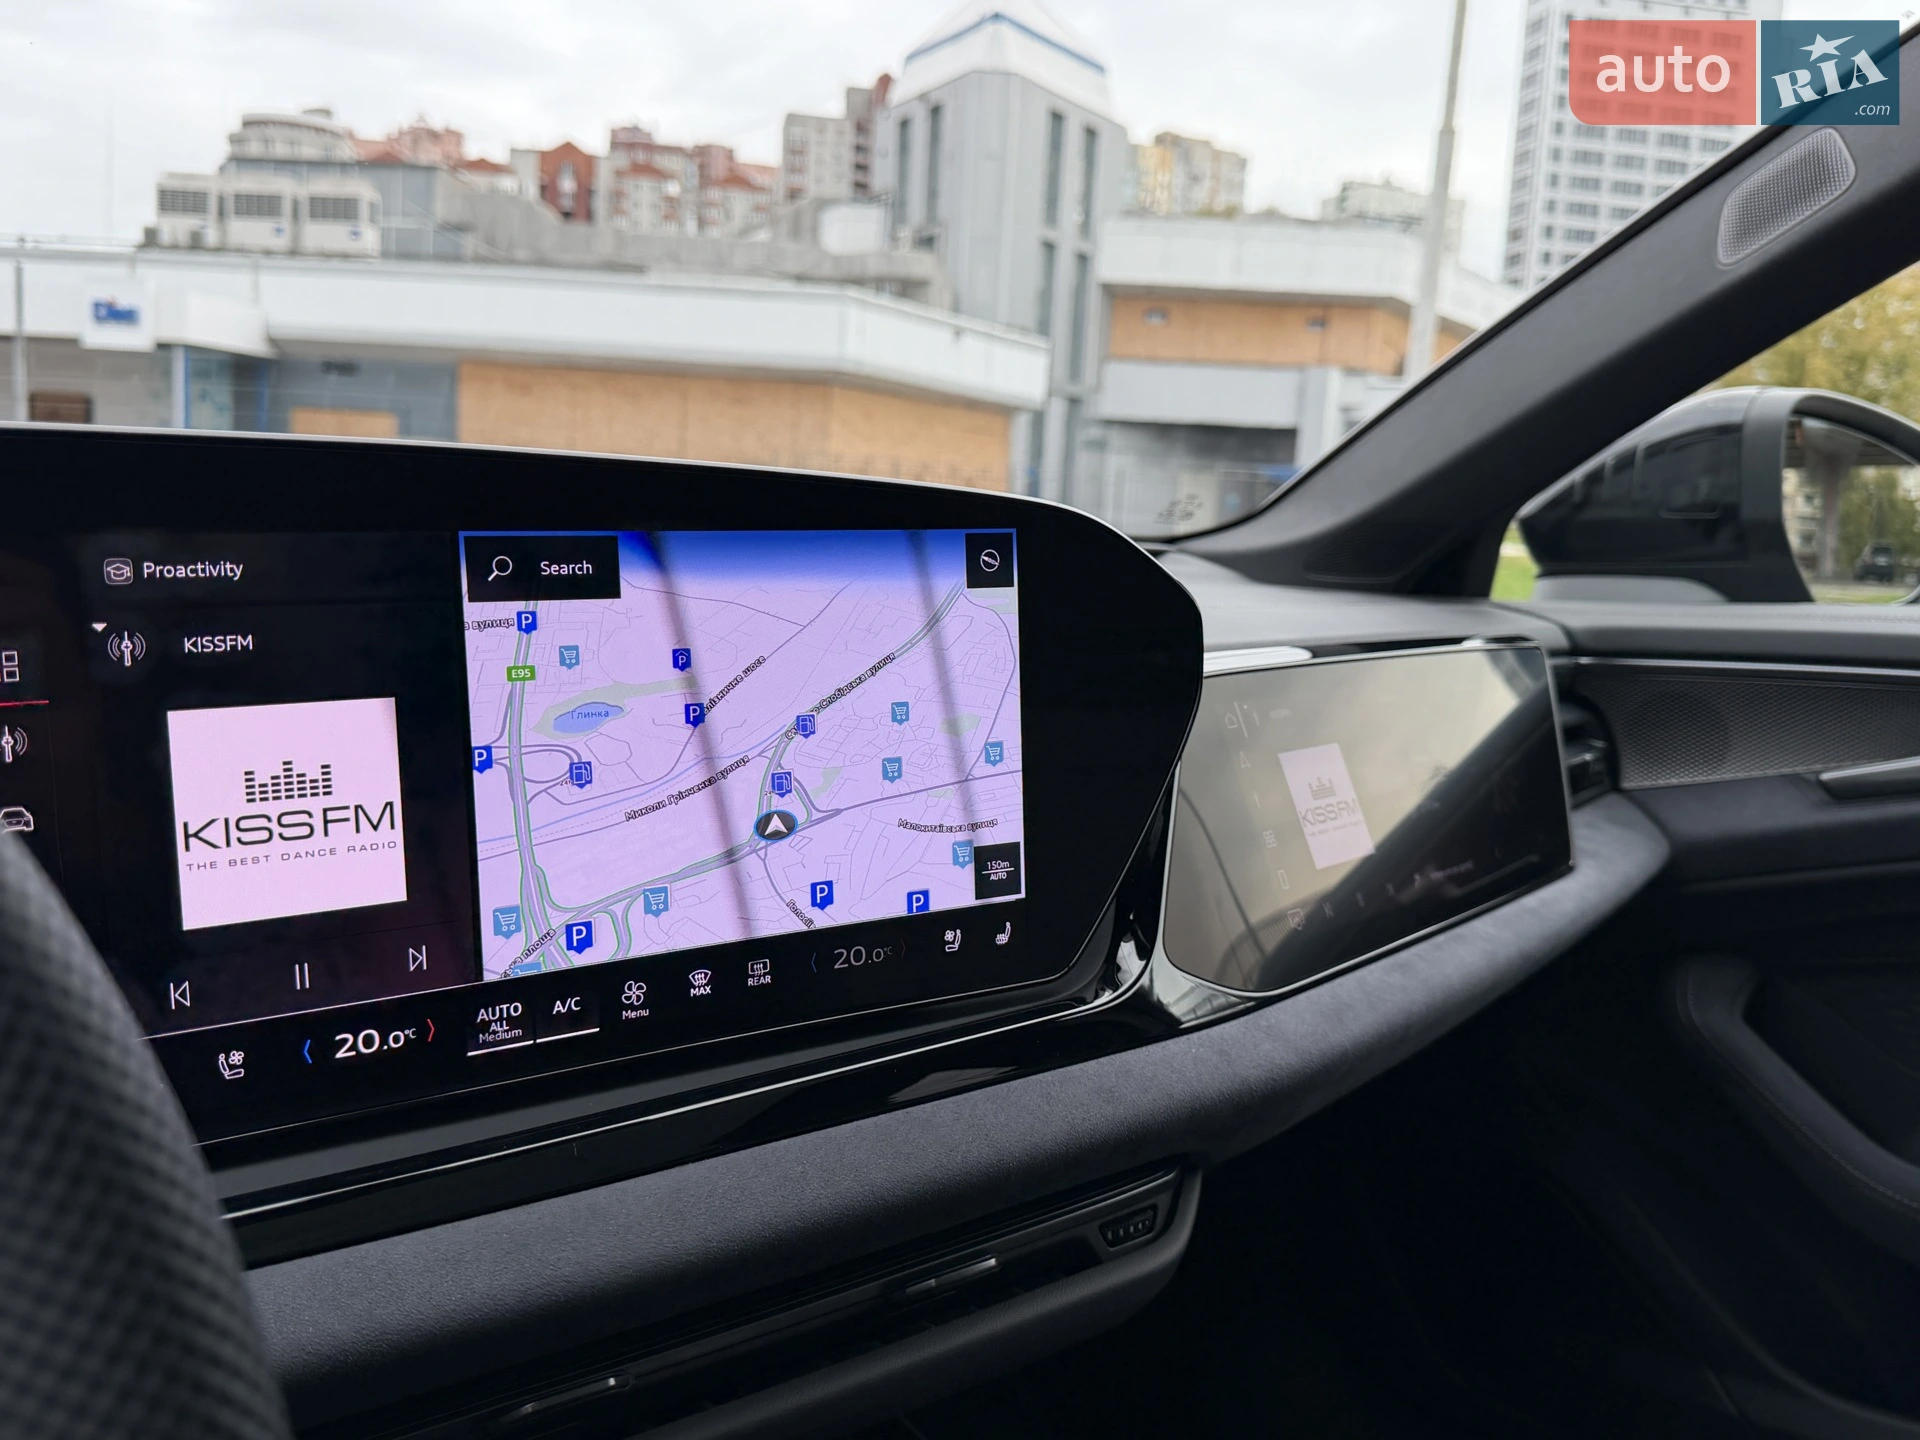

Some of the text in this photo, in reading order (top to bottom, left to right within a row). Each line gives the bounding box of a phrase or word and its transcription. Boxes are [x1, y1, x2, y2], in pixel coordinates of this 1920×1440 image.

[143, 560, 244, 581] Proactivity
[540, 560, 593, 576] Search
[471, 618, 515, 632] вулиця
[183, 634, 254, 653] KISSFM
[511, 668, 531, 678] E95
[624, 799, 668, 822] Миколи
[715, 755, 751, 781] вулиця
[186, 841, 397, 872] THE BEST DANCE RADIO
[987, 860, 1010, 870] 150m
[989, 871, 1007, 880] AUTO
[522, 929, 556, 959] площа
[747, 975, 772, 987] REAR
[690, 985, 712, 997] MAX
[476, 1002, 523, 1023] AUTO
[552, 997, 582, 1015] A/C
[622, 1008, 650, 1020] Menu
[489, 1020, 510, 1033] ALL
[478, 1028, 523, 1044] Medium
